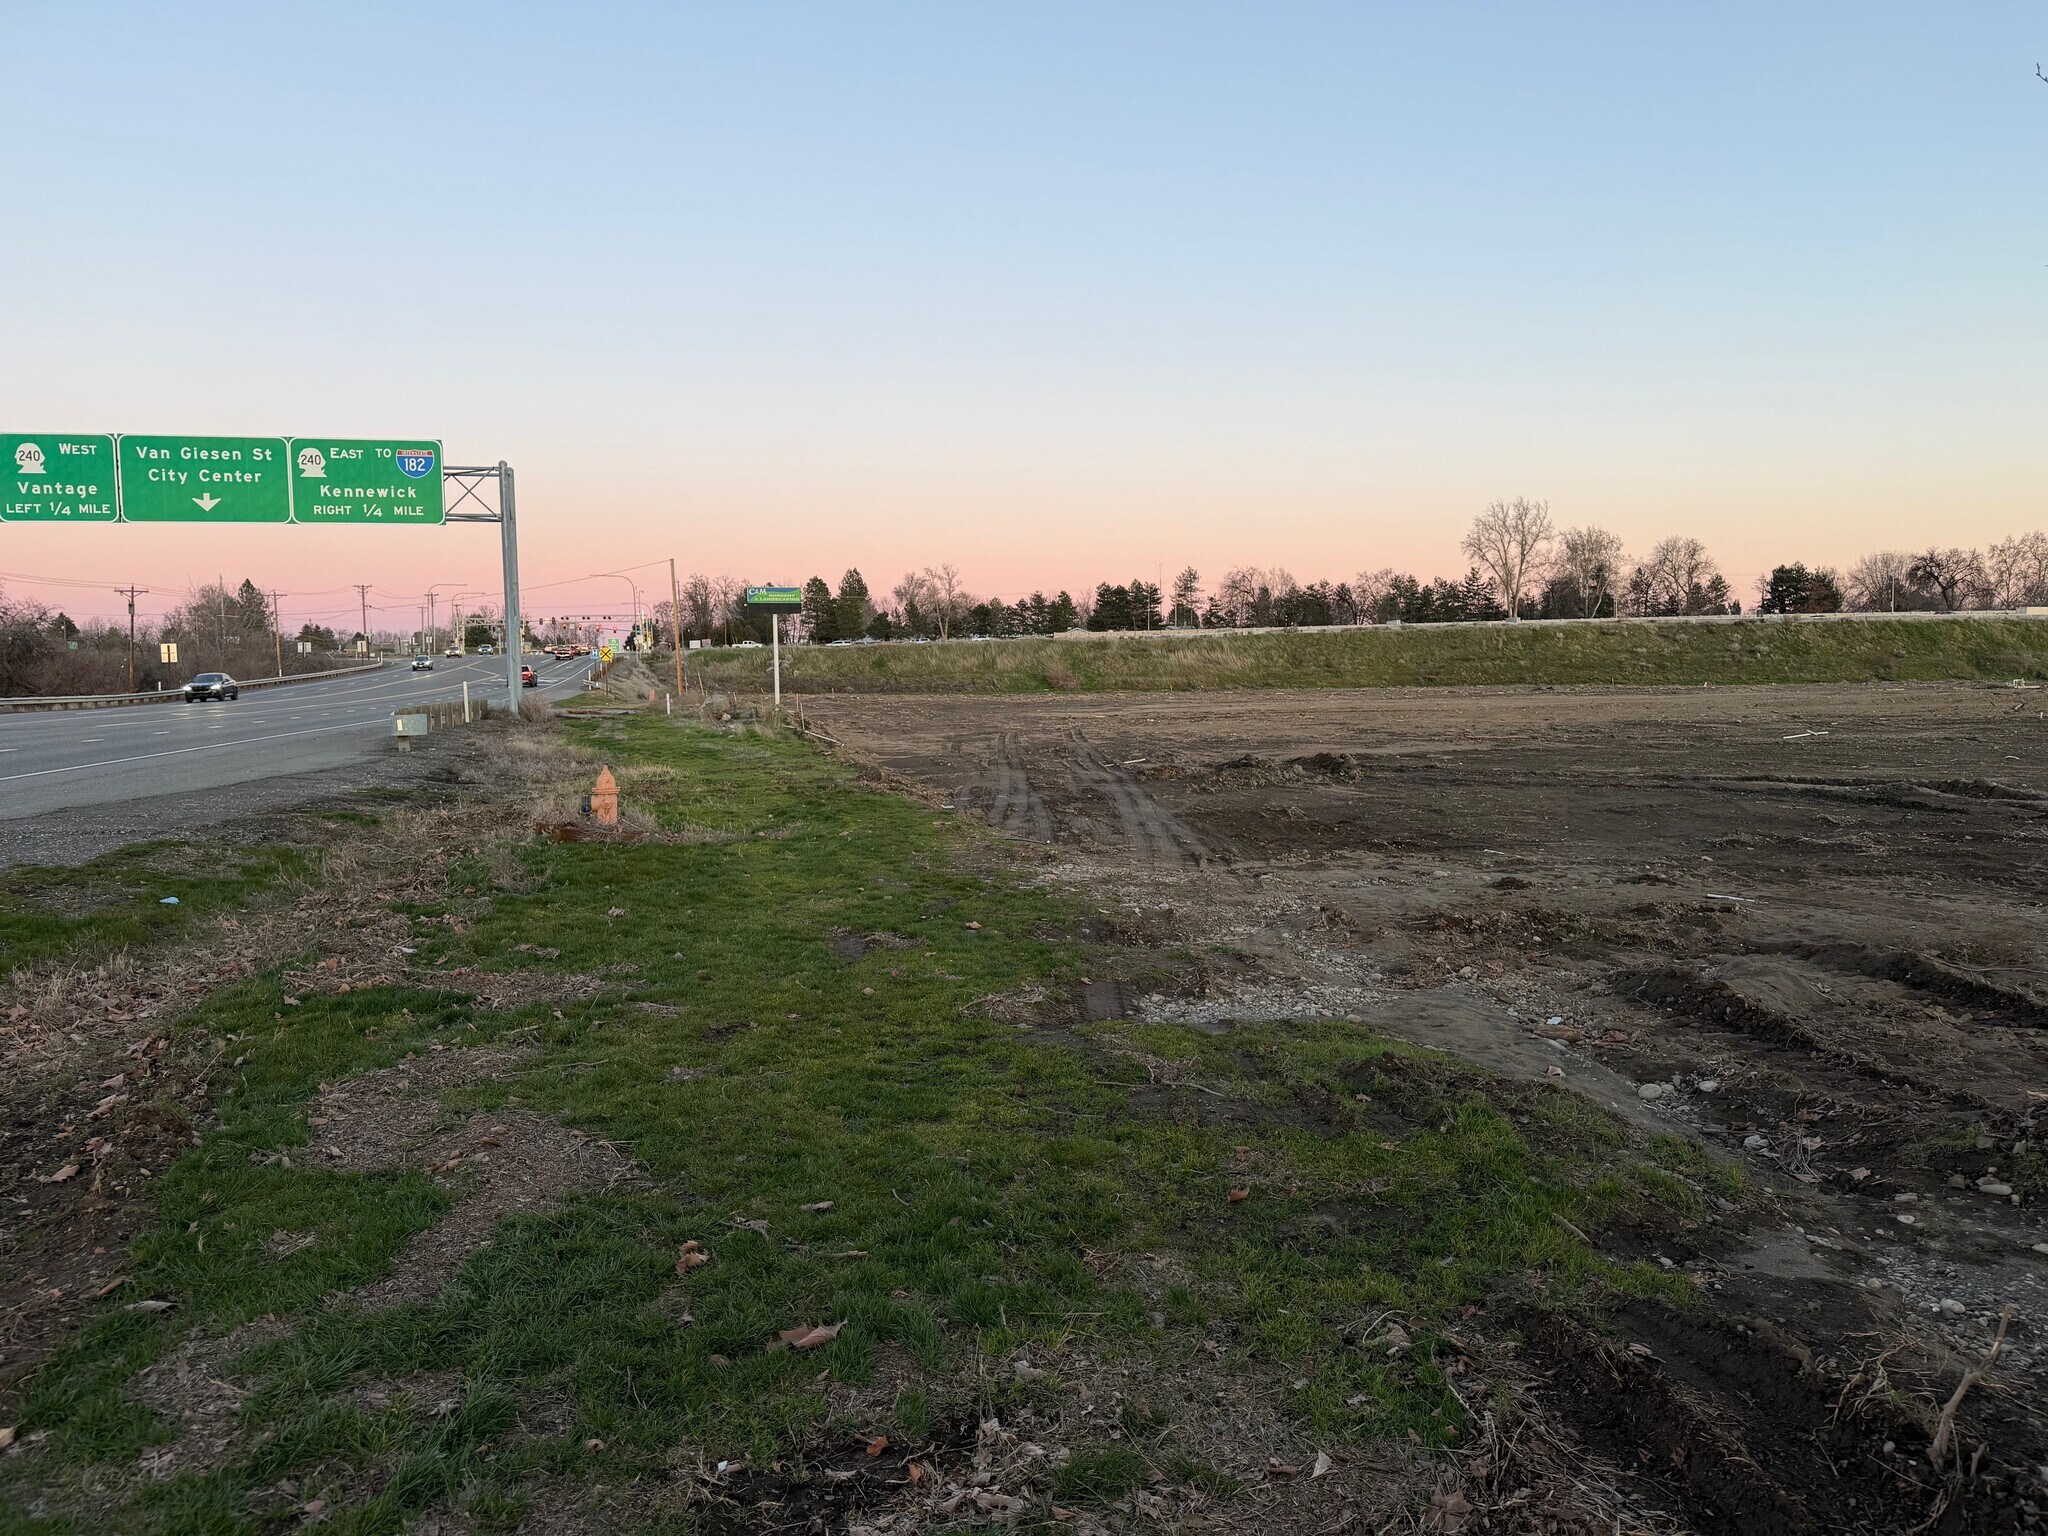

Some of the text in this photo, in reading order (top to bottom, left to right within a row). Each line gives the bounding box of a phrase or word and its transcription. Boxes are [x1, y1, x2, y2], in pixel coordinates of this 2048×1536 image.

[18, 450, 41, 461] 240
[58, 443, 97, 454] WEST
[136, 446, 272, 461] Van Giesen St
[330, 448, 392, 459] EAST TO
[301, 454, 321, 466] 240
[404, 458, 426, 472] 182
[148, 468, 262, 484] City Center
[17, 481, 98, 499] Vantage
[320, 484, 417, 498] Kennewick
[6, 502, 111, 516] LEFT 1/4 MILE
[313, 503, 424, 517] RIGHT 1/4 MILE
